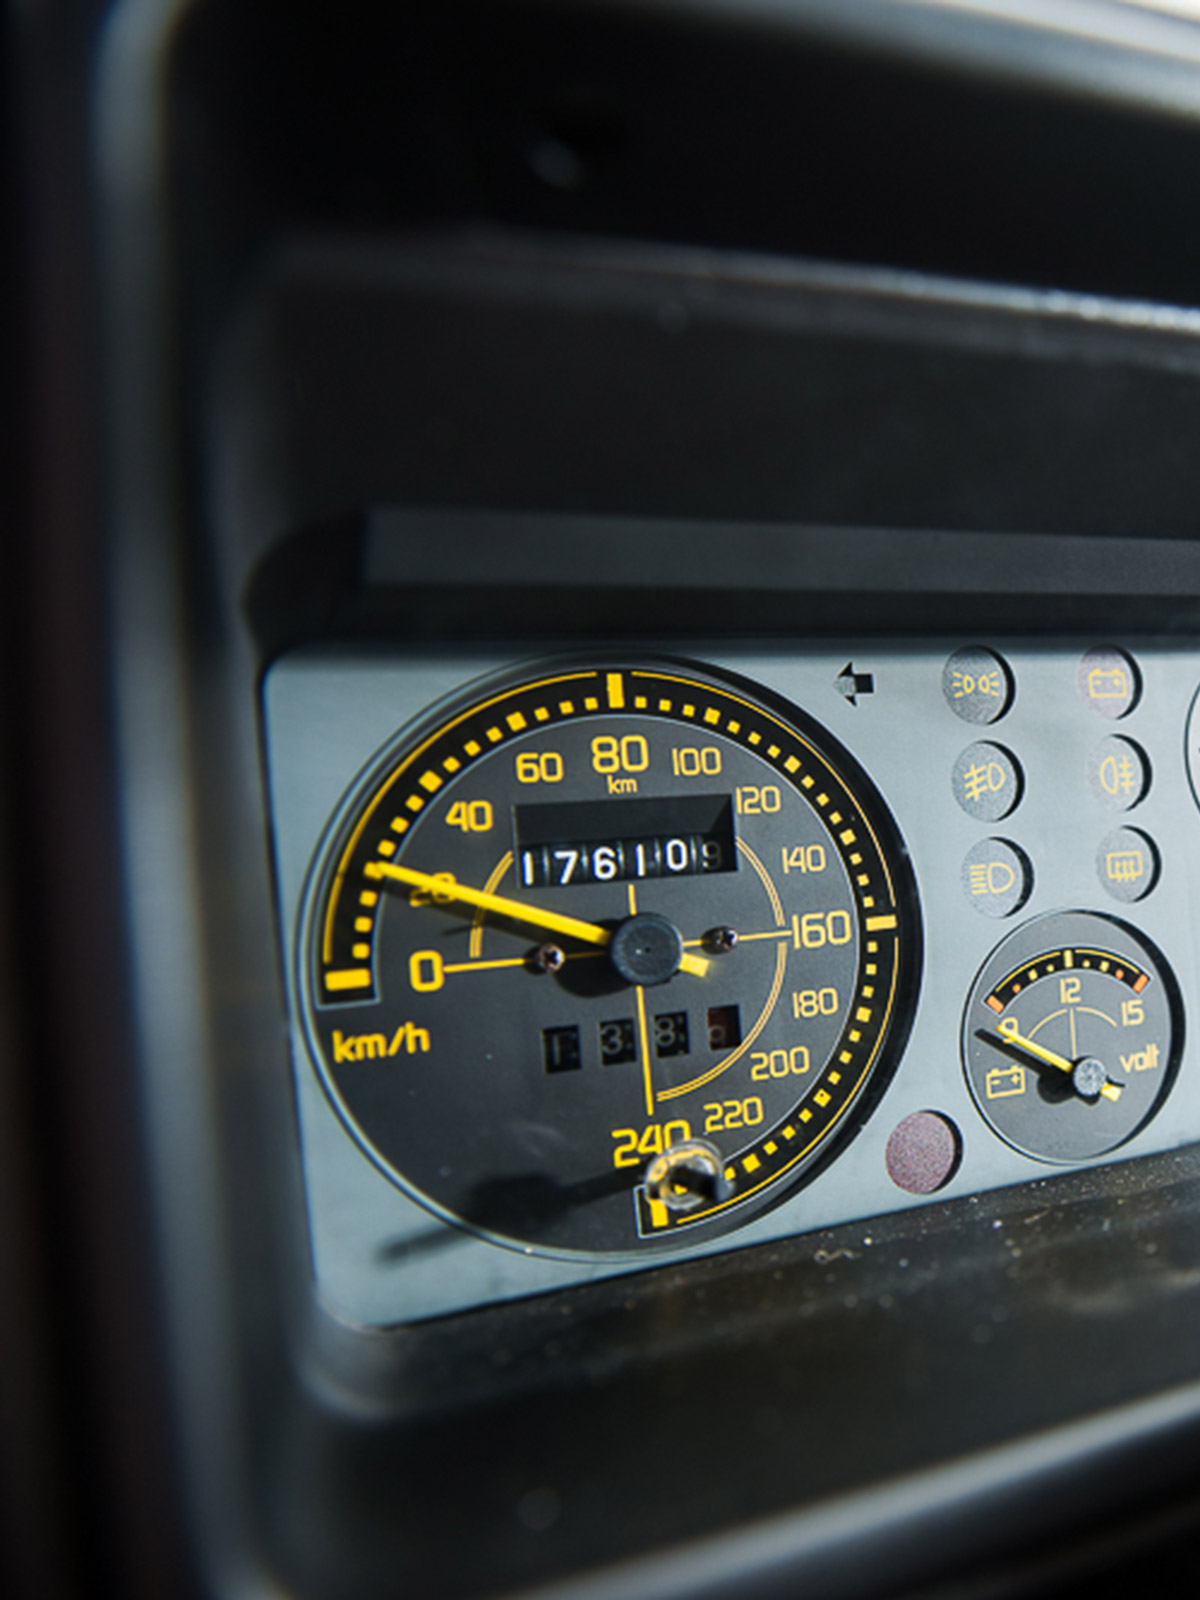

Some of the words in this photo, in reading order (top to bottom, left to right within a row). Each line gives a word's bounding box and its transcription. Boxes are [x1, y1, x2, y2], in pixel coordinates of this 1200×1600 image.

[515, 752, 564, 783] 60
[591, 735, 649, 773] 80
[672, 747, 722, 776] 100
[607, 775, 638, 794] km
[735, 786, 781, 815] 120
[445, 800, 493, 832] 40
[781, 844, 826, 874] 140
[791, 909, 852, 950] 160
[409, 949, 445, 992] 0
[792, 987, 839, 1019] 180
[1060, 977, 1082, 1004] 12
[1121, 999, 1145, 1027] 15
[332, 1021, 431, 1063] km/h
[1119, 1043, 1160, 1073] volt
[750, 1046, 810, 1081] 200
[703, 1096, 764, 1132] 220
[611, 1119, 692, 1168] 240
